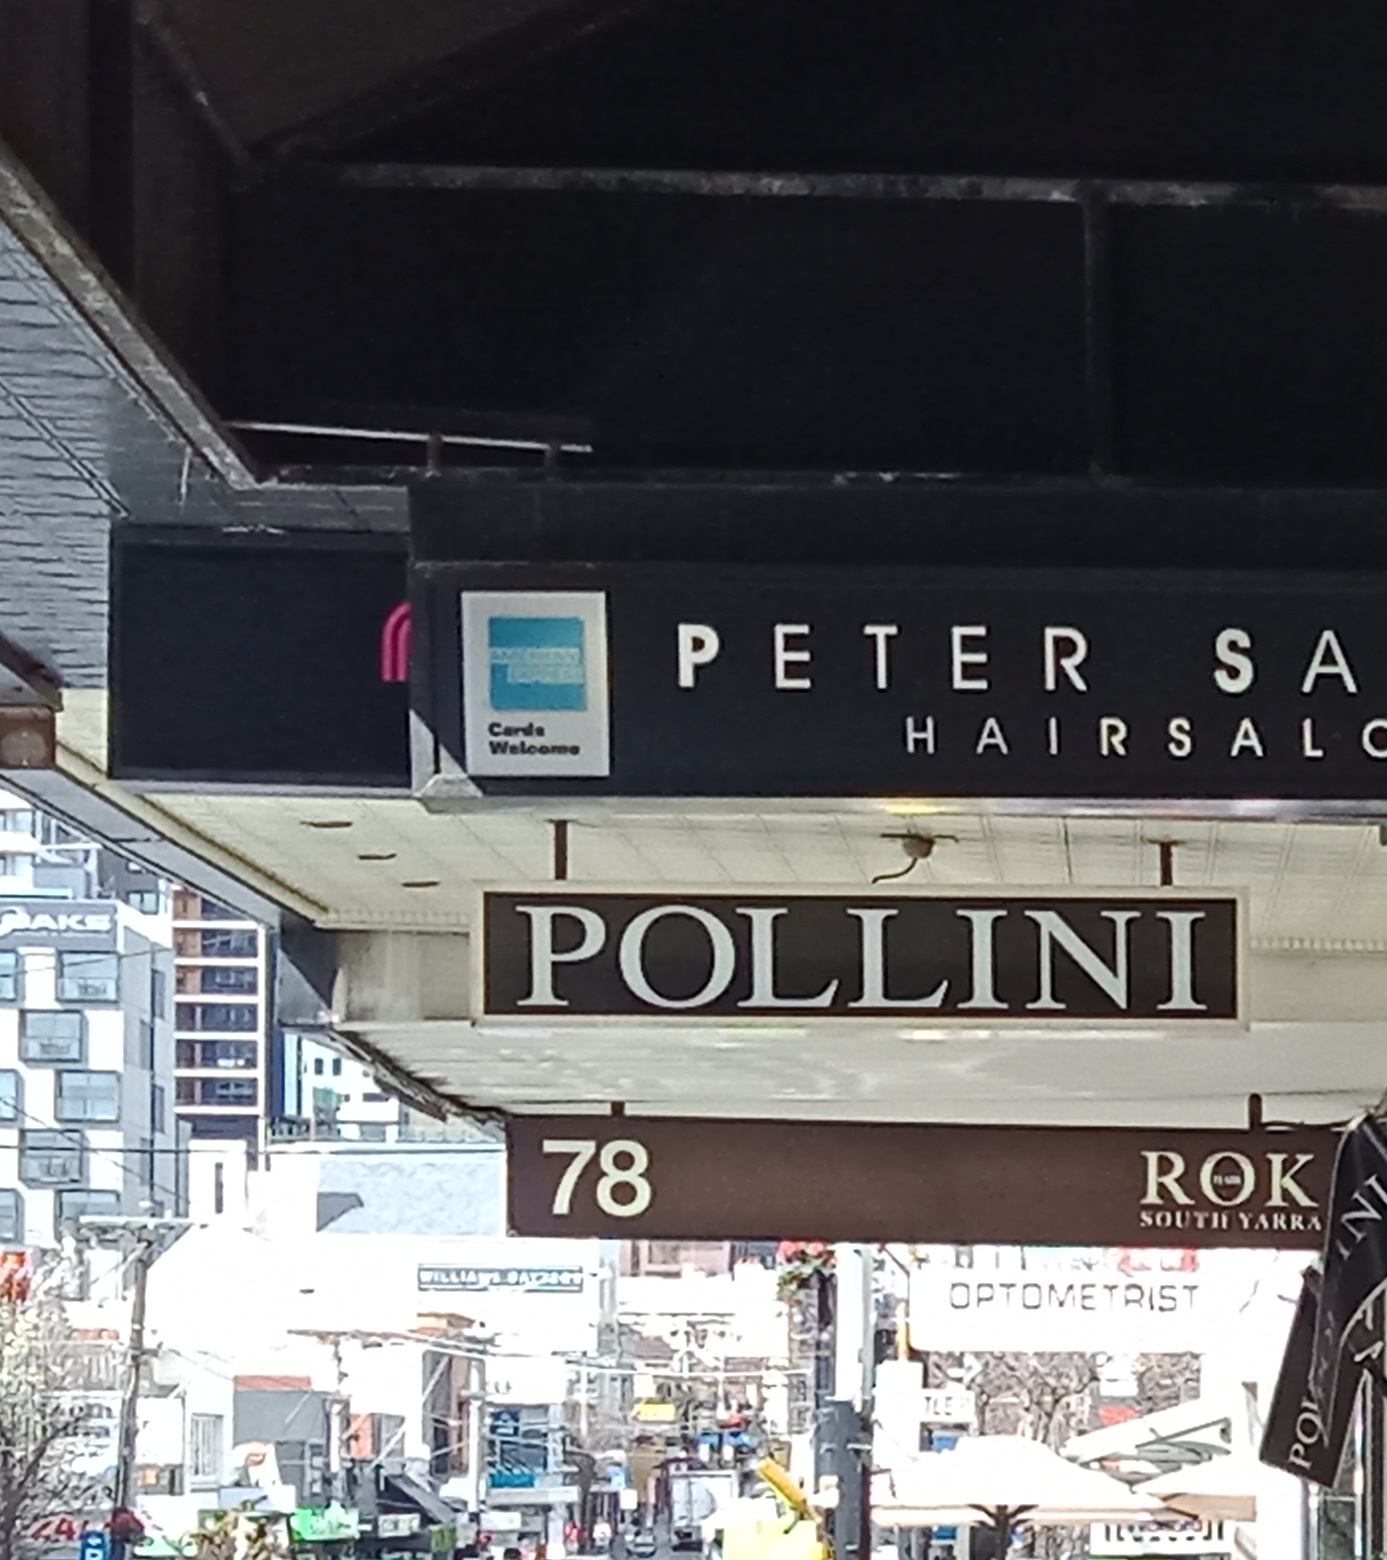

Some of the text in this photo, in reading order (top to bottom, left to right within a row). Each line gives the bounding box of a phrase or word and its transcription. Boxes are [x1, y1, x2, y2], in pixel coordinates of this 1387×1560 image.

[677, 622, 1089, 692] PETER
[487, 721, 546, 738] Cards
[488, 740, 581, 756] Welcome
[514, 904, 1208, 1010] POLLINI
[541, 1138, 653, 1218] 78
[1139, 1150, 1320, 1207] ROK
[1139, 1209, 1323, 1231] SOUTH YARRA
[949, 1281, 1200, 1314] OPTOMETRIST
